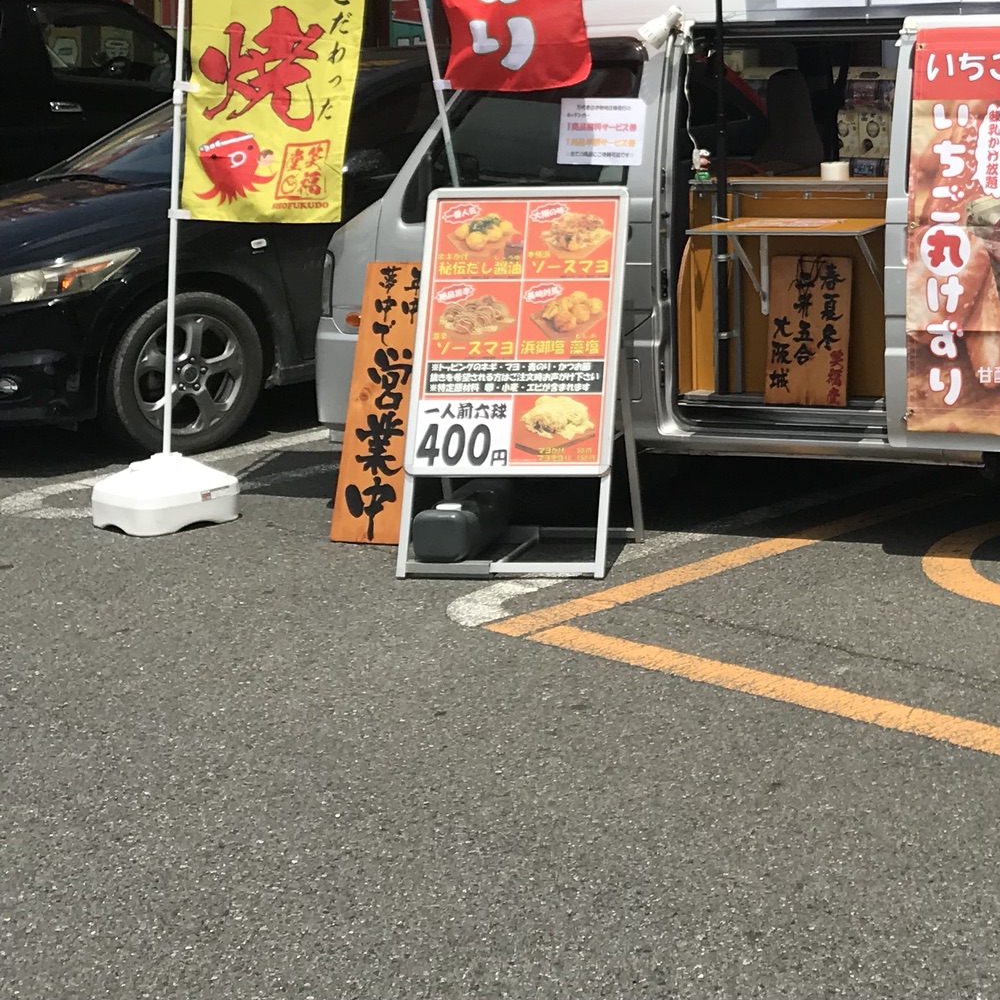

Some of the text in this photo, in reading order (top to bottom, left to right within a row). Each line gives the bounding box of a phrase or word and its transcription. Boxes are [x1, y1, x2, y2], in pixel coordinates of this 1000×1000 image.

[920, 103, 971, 406] いちご丸けずり
[531, 260, 609, 274] ソースマヨ
[436, 341, 513, 355] ソースマヨ
[520, 340, 565, 355] 浜御塩
[416, 423, 508, 467] 400円
